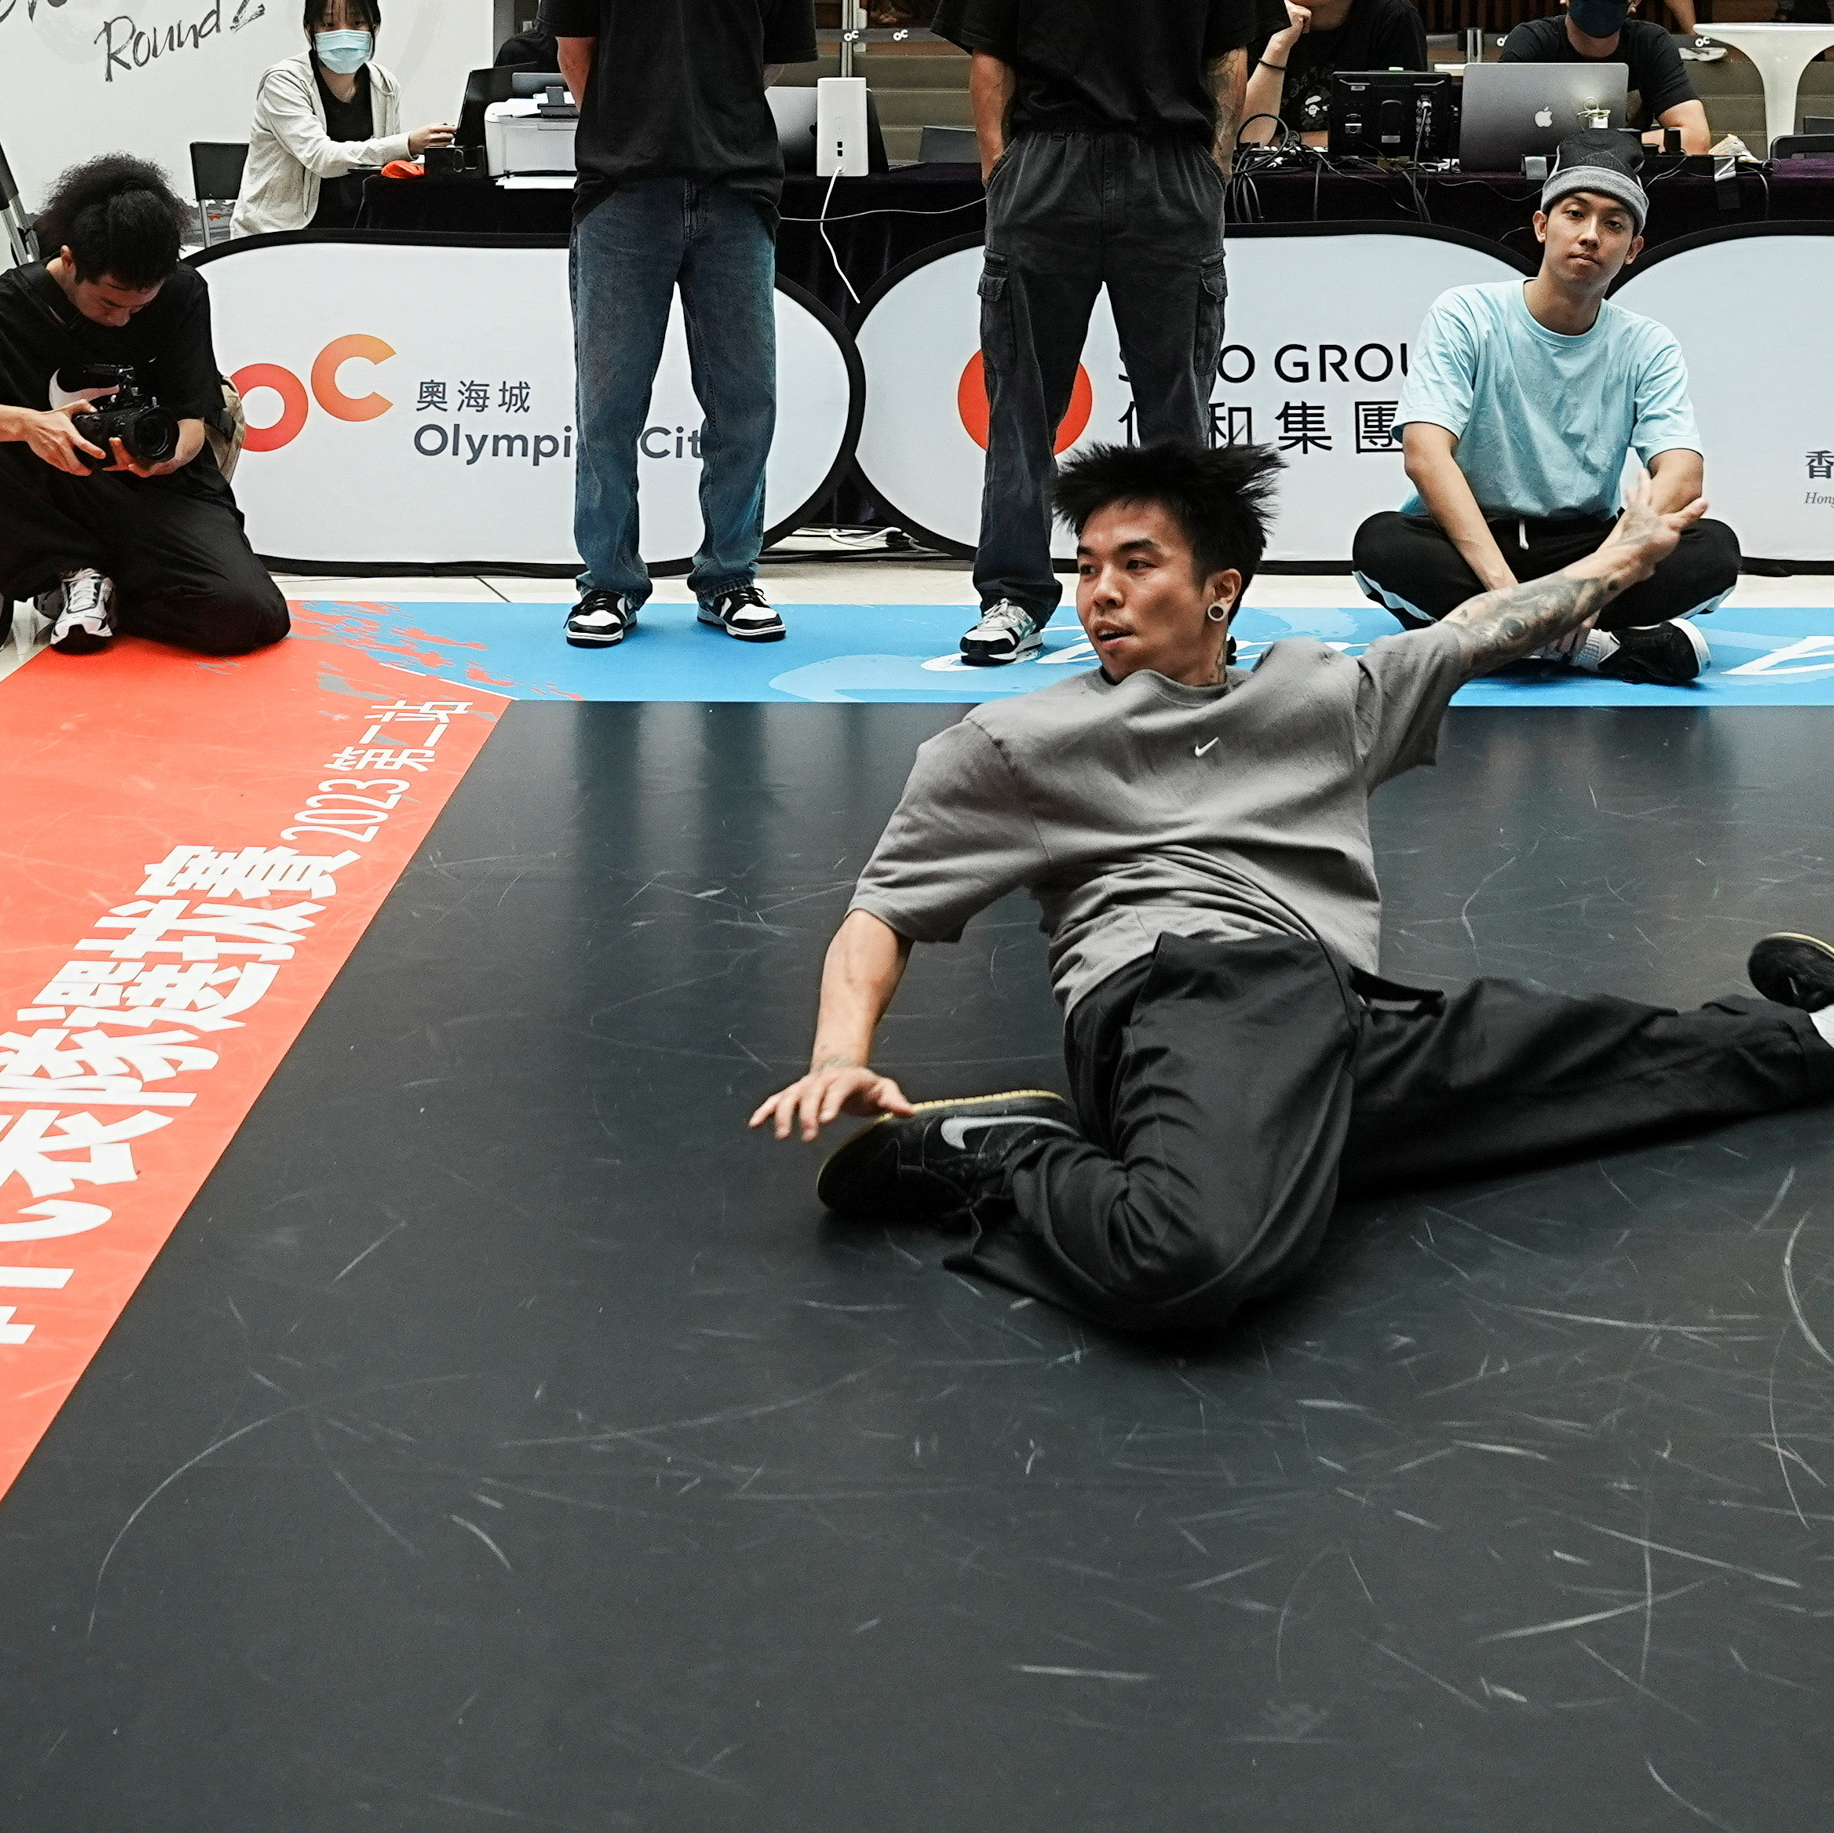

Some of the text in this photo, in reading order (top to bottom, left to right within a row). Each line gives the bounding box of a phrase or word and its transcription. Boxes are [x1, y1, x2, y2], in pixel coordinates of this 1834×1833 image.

[415, 379, 531, 414] 奧海城
[413, 423, 704, 466] Olympi Cit
[323, 699, 474, 772] 第二站
[280, 778, 411, 843] 2023
